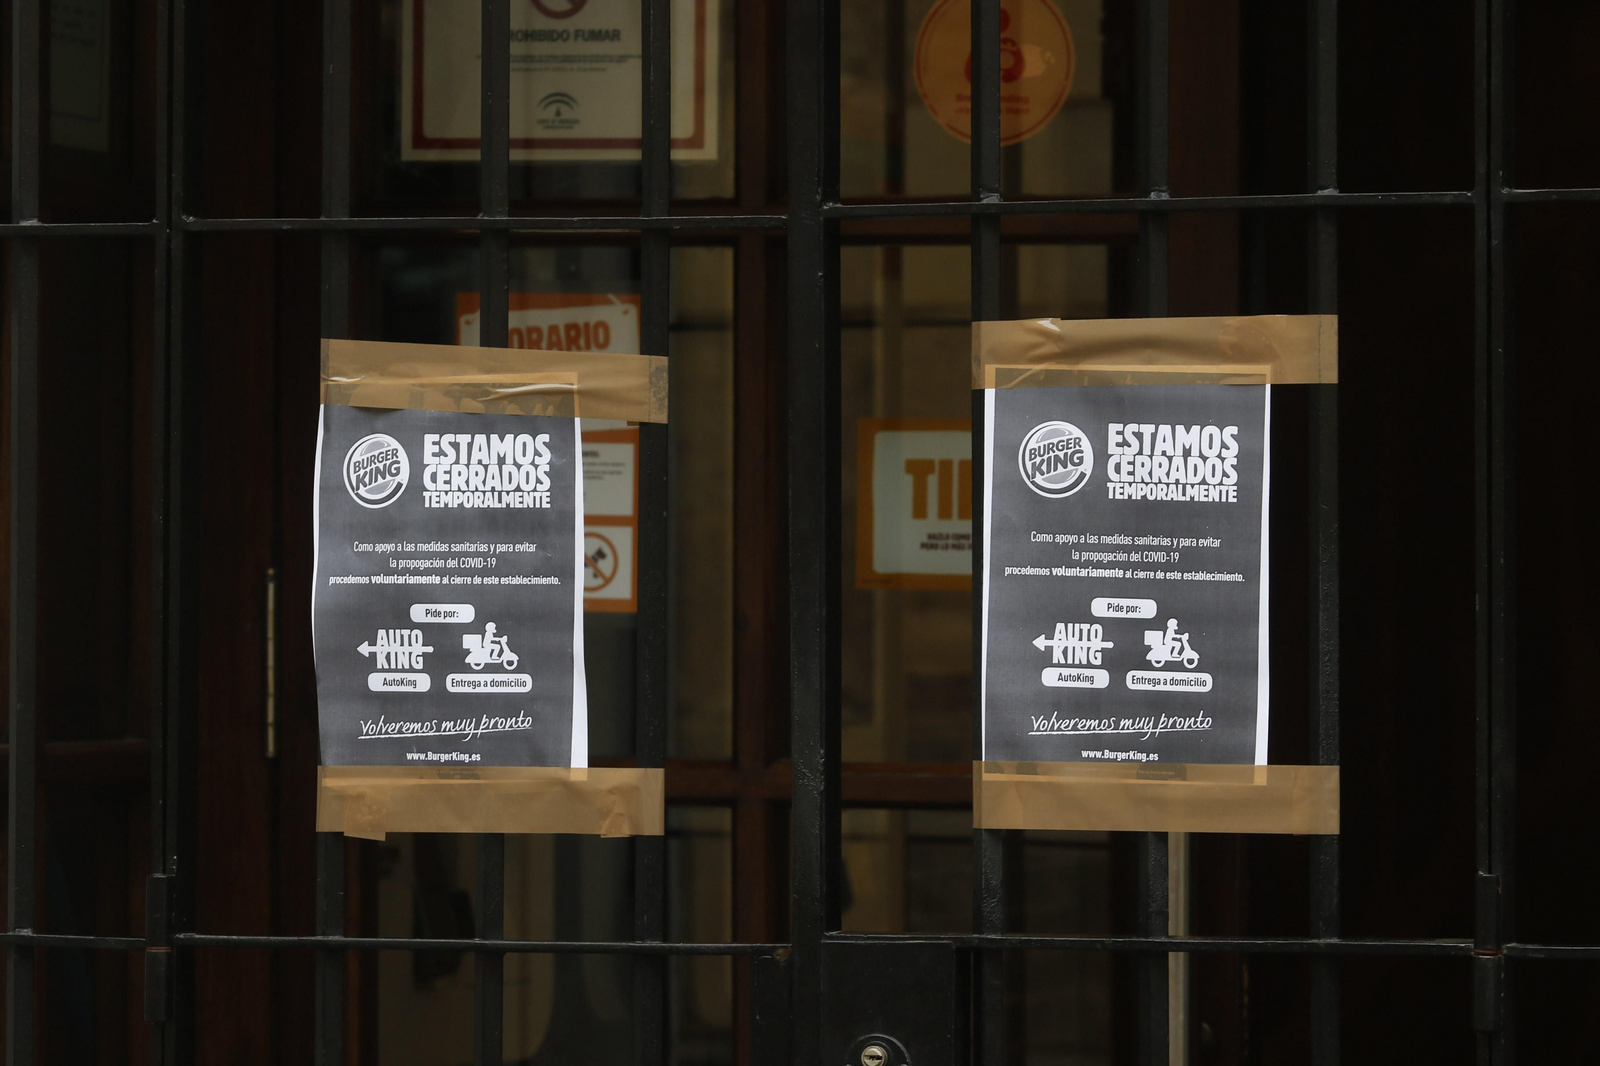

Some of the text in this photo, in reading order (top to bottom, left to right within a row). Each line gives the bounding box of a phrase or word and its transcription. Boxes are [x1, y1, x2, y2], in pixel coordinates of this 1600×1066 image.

[509, 29, 621, 42] ROHIBIDO FUMAR
[423, 433, 550, 465] ESTAMOS
[1028, 436, 1082, 462] BURGER
[1107, 423, 1239, 458] ESTAMOS
[353, 448, 399, 474] BURGER
[1030, 449, 1084, 480] KING
[1107, 454, 1238, 485] CERRADOS
[355, 460, 401, 492] KING
[423, 464, 550, 491] CERRADOS
[423, 492, 550, 508] TEMPORALMENTE
[1107, 482, 1237, 502] TEMPORALMENTE
[353, 541, 536, 554] Como apoyo a las medidas sanitarias y para evitar
[1031, 531, 1220, 549] Como apoyo a las medidas sanitarias y para evitar
[390, 558, 496, 570] la propogación del COVID-19
[1072, 549, 1179, 563] la propogación del COVID-19
[329, 574, 561, 586] procedemos voluntariamente al cierre de este establecimiento.
[1005, 565, 1245, 582] procedemos voluntariamente al cierre de este establecimiento.
[426, 609, 459, 620] Pide por:
[1107, 603, 1141, 616] Pide por:
[377, 629, 423, 647] AUTO
[1054, 623, 1102, 642] AUTO
[376, 650, 423, 669] KING
[1053, 644, 1102, 665] KING
[382, 678, 416, 688] AutoKing
[452, 679, 481, 689] Entrega
[490, 679, 527, 688] domicilio
[1058, 673, 1094, 685] AutoKing
[1132, 676, 1161, 687] Entrega
[1169, 677, 1207, 687] domicilio
[360, 710, 532, 741] Volveremos muy pronto
[1031, 710, 1212, 740] Volveremos muy pronto
[407, 752, 481, 763] www.BurgerKing.es
[1081, 749, 1158, 762] www.BurgerKing.es
